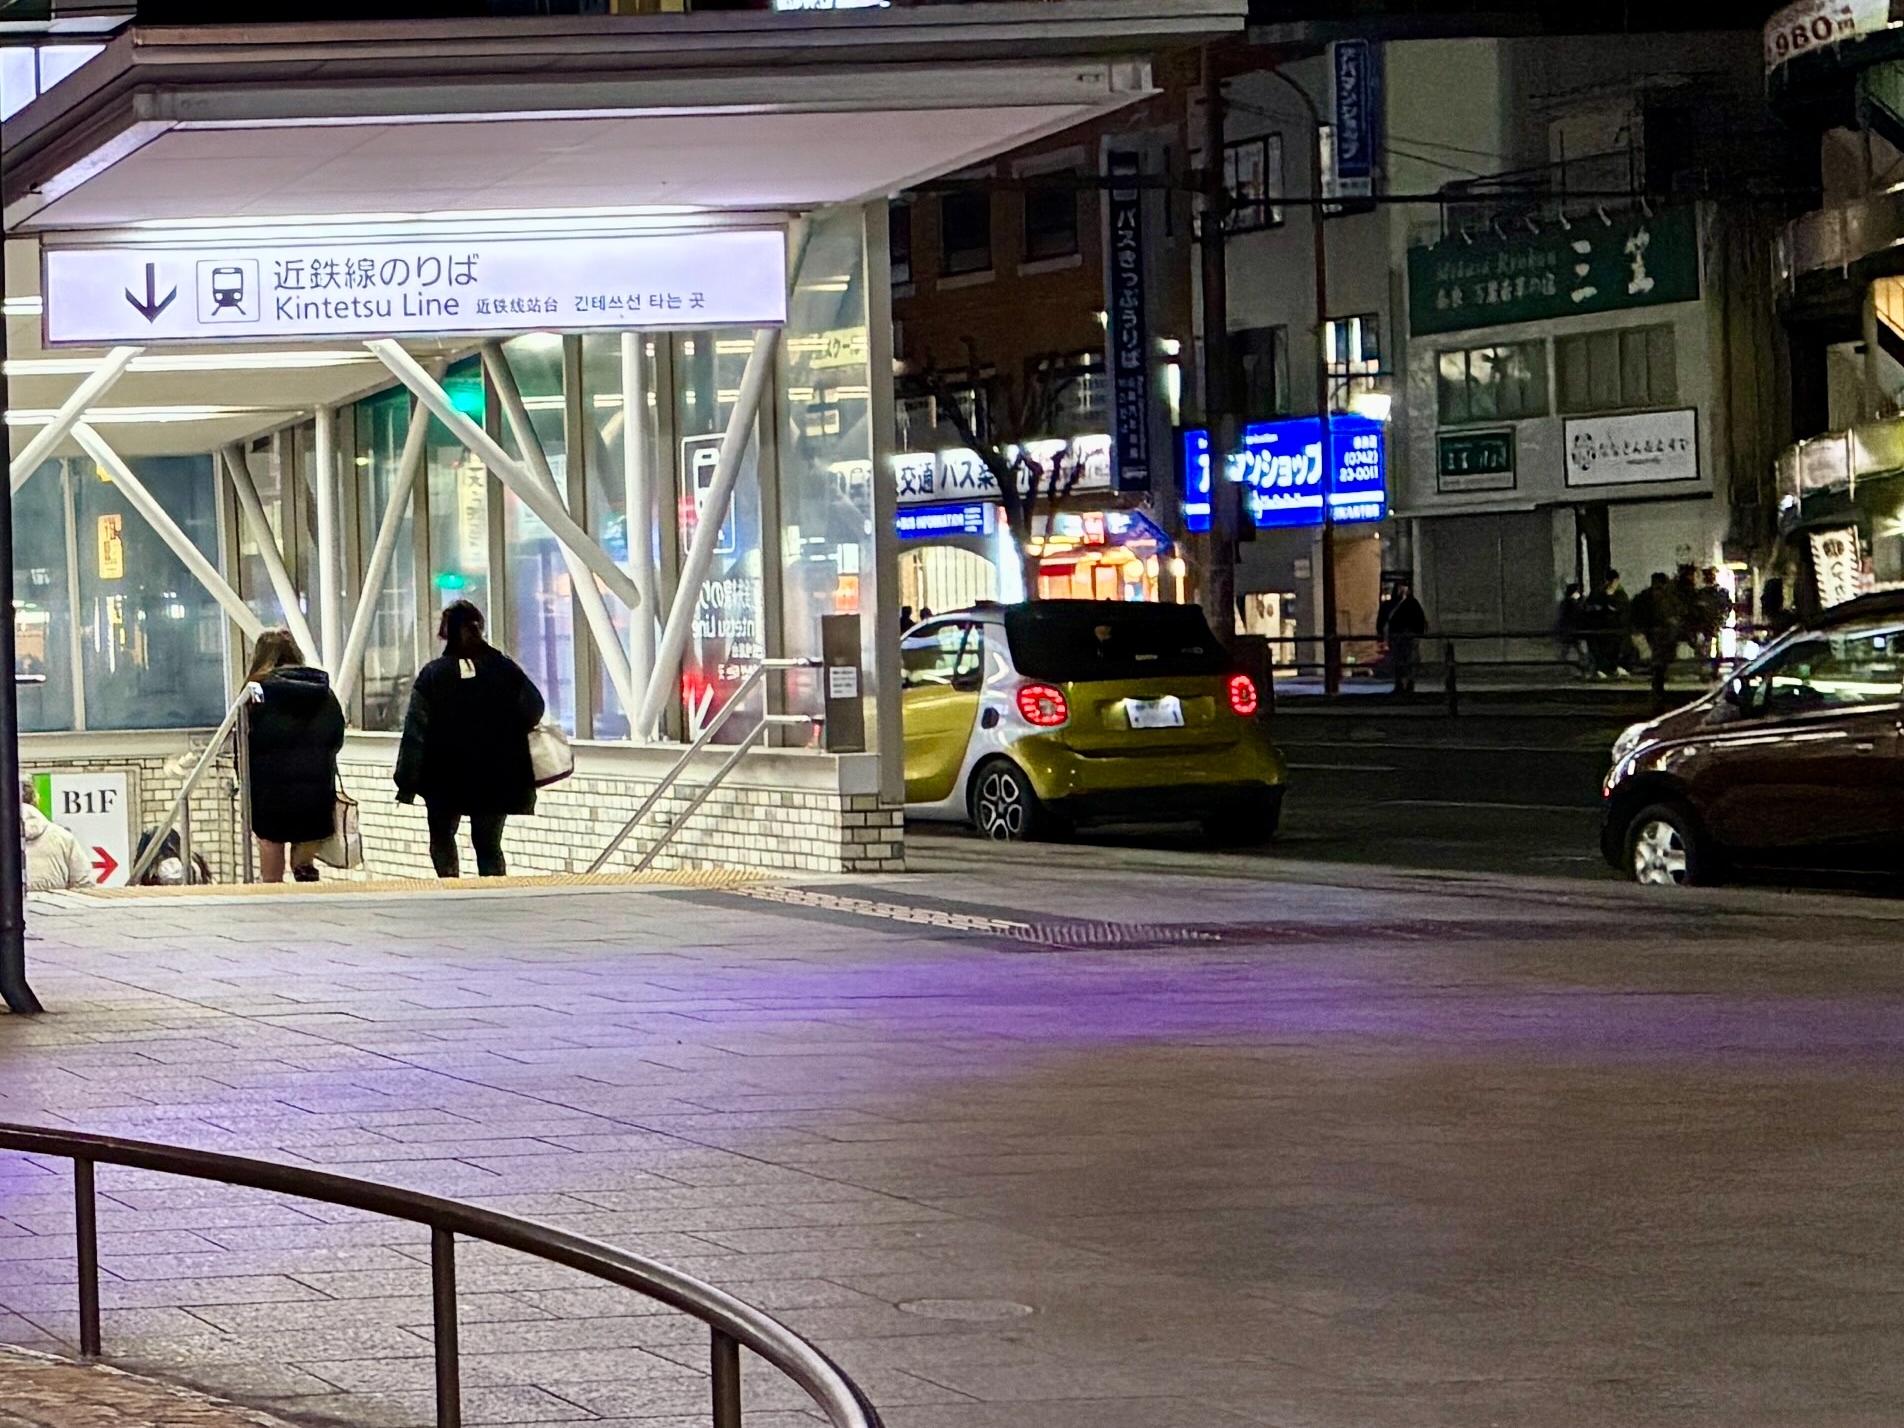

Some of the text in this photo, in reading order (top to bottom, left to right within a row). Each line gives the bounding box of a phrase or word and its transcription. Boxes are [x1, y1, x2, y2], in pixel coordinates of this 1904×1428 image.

[273, 253, 480, 290] 近鉄線のりば
[275, 291, 460, 321] Kintetsu Line
[649, 291, 683, 310] 타는
[688, 290, 707, 310] 곳
[62, 788, 118, 815] B1F
